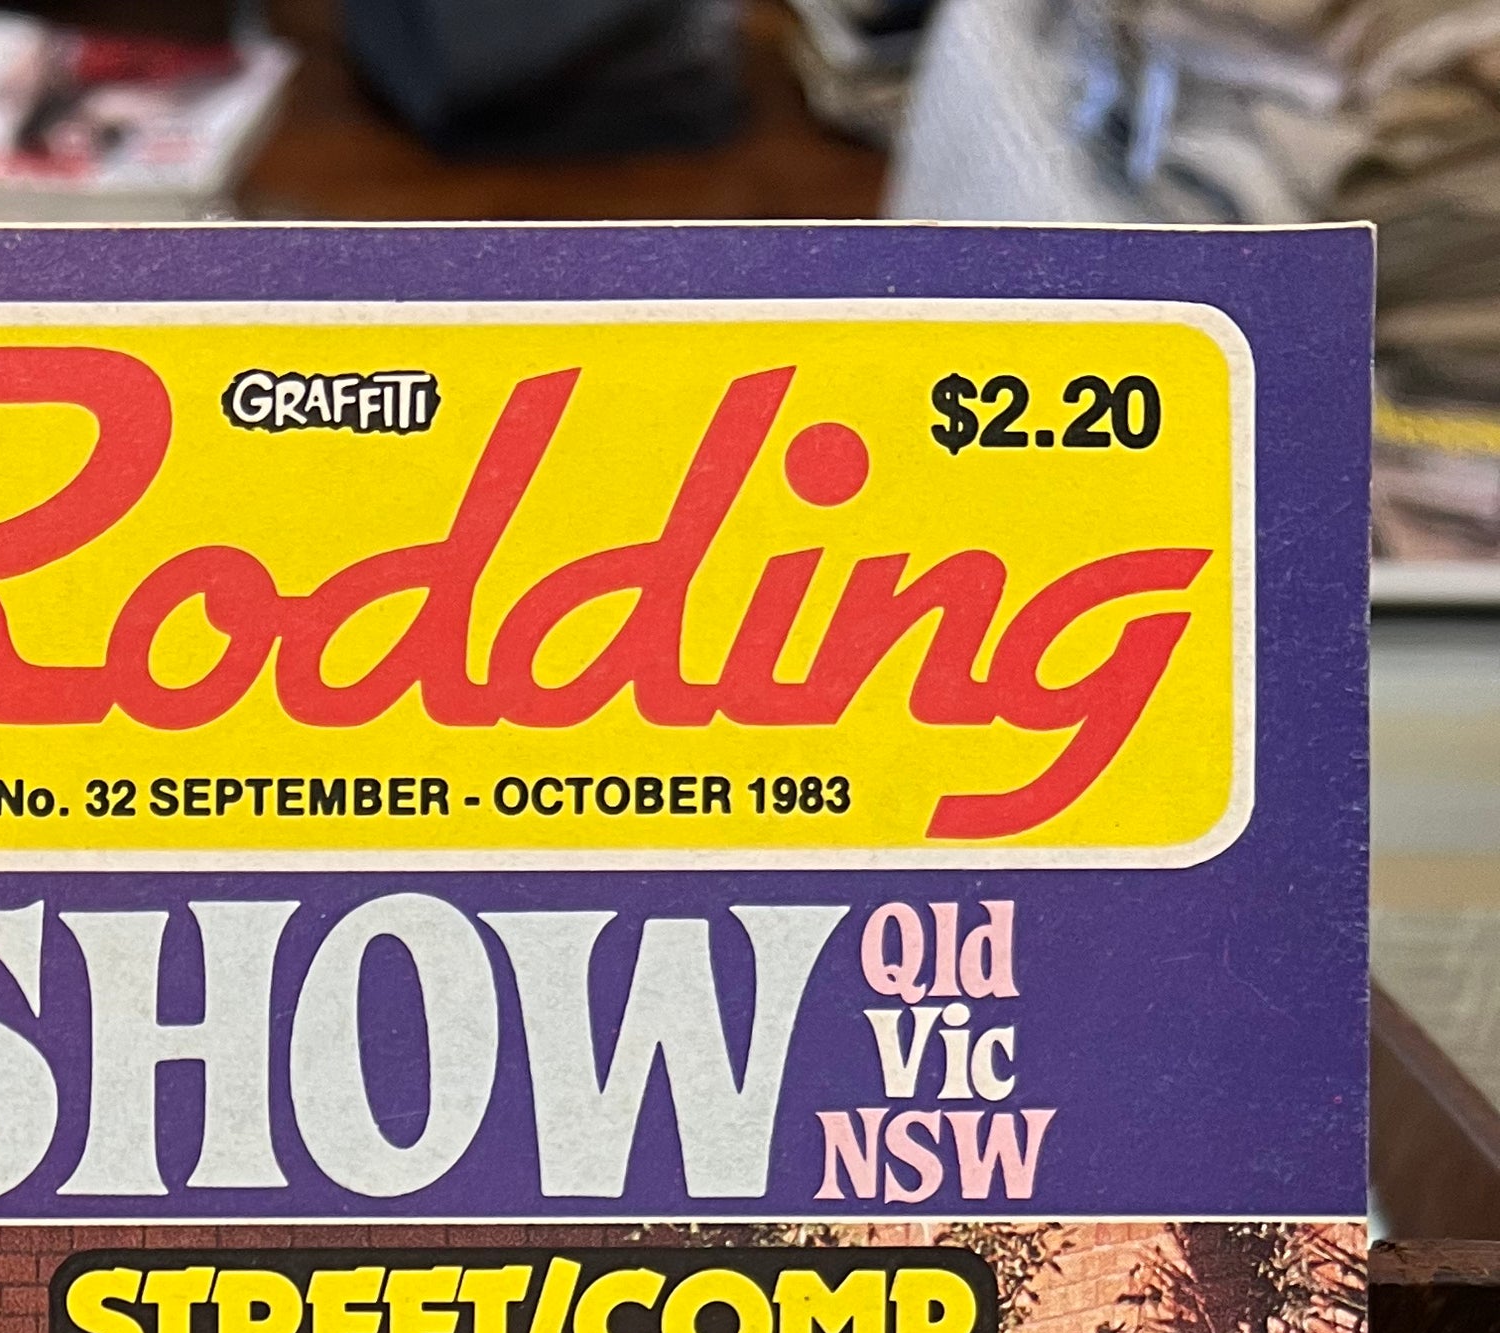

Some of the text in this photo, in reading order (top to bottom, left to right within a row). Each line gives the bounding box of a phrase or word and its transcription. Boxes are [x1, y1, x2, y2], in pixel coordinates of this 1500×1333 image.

[231, 371, 434, 430] GRAFFITI
[931, 373, 1161, 455] $2.20
[84, 779, 136, 816] 32
[149, 778, 450, 816] SEPTEMBER
[492, 777, 732, 816] OCTOBER
[746, 776, 852, 815] 1983
[860, 900, 1019, 1005] Qld
[864, 1005, 1017, 1102] Vic
[813, 1107, 1056, 1204] NSW
